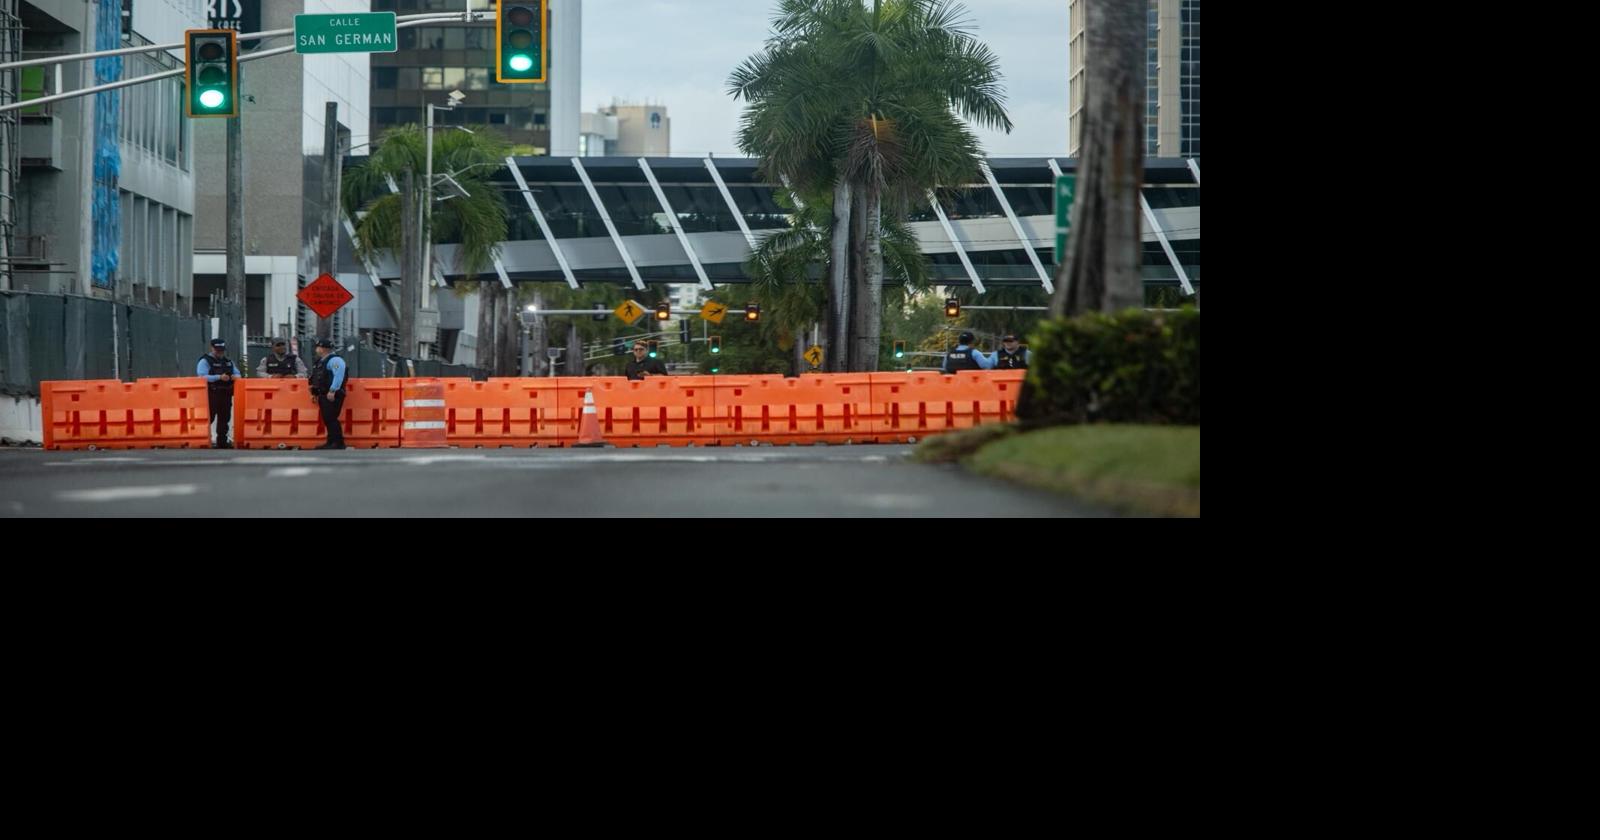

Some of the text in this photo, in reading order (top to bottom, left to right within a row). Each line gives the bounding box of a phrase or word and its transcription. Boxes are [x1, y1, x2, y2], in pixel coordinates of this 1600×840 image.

[329, 18, 360, 27] CALLE
[300, 33, 391, 46] SAN GERMAN
